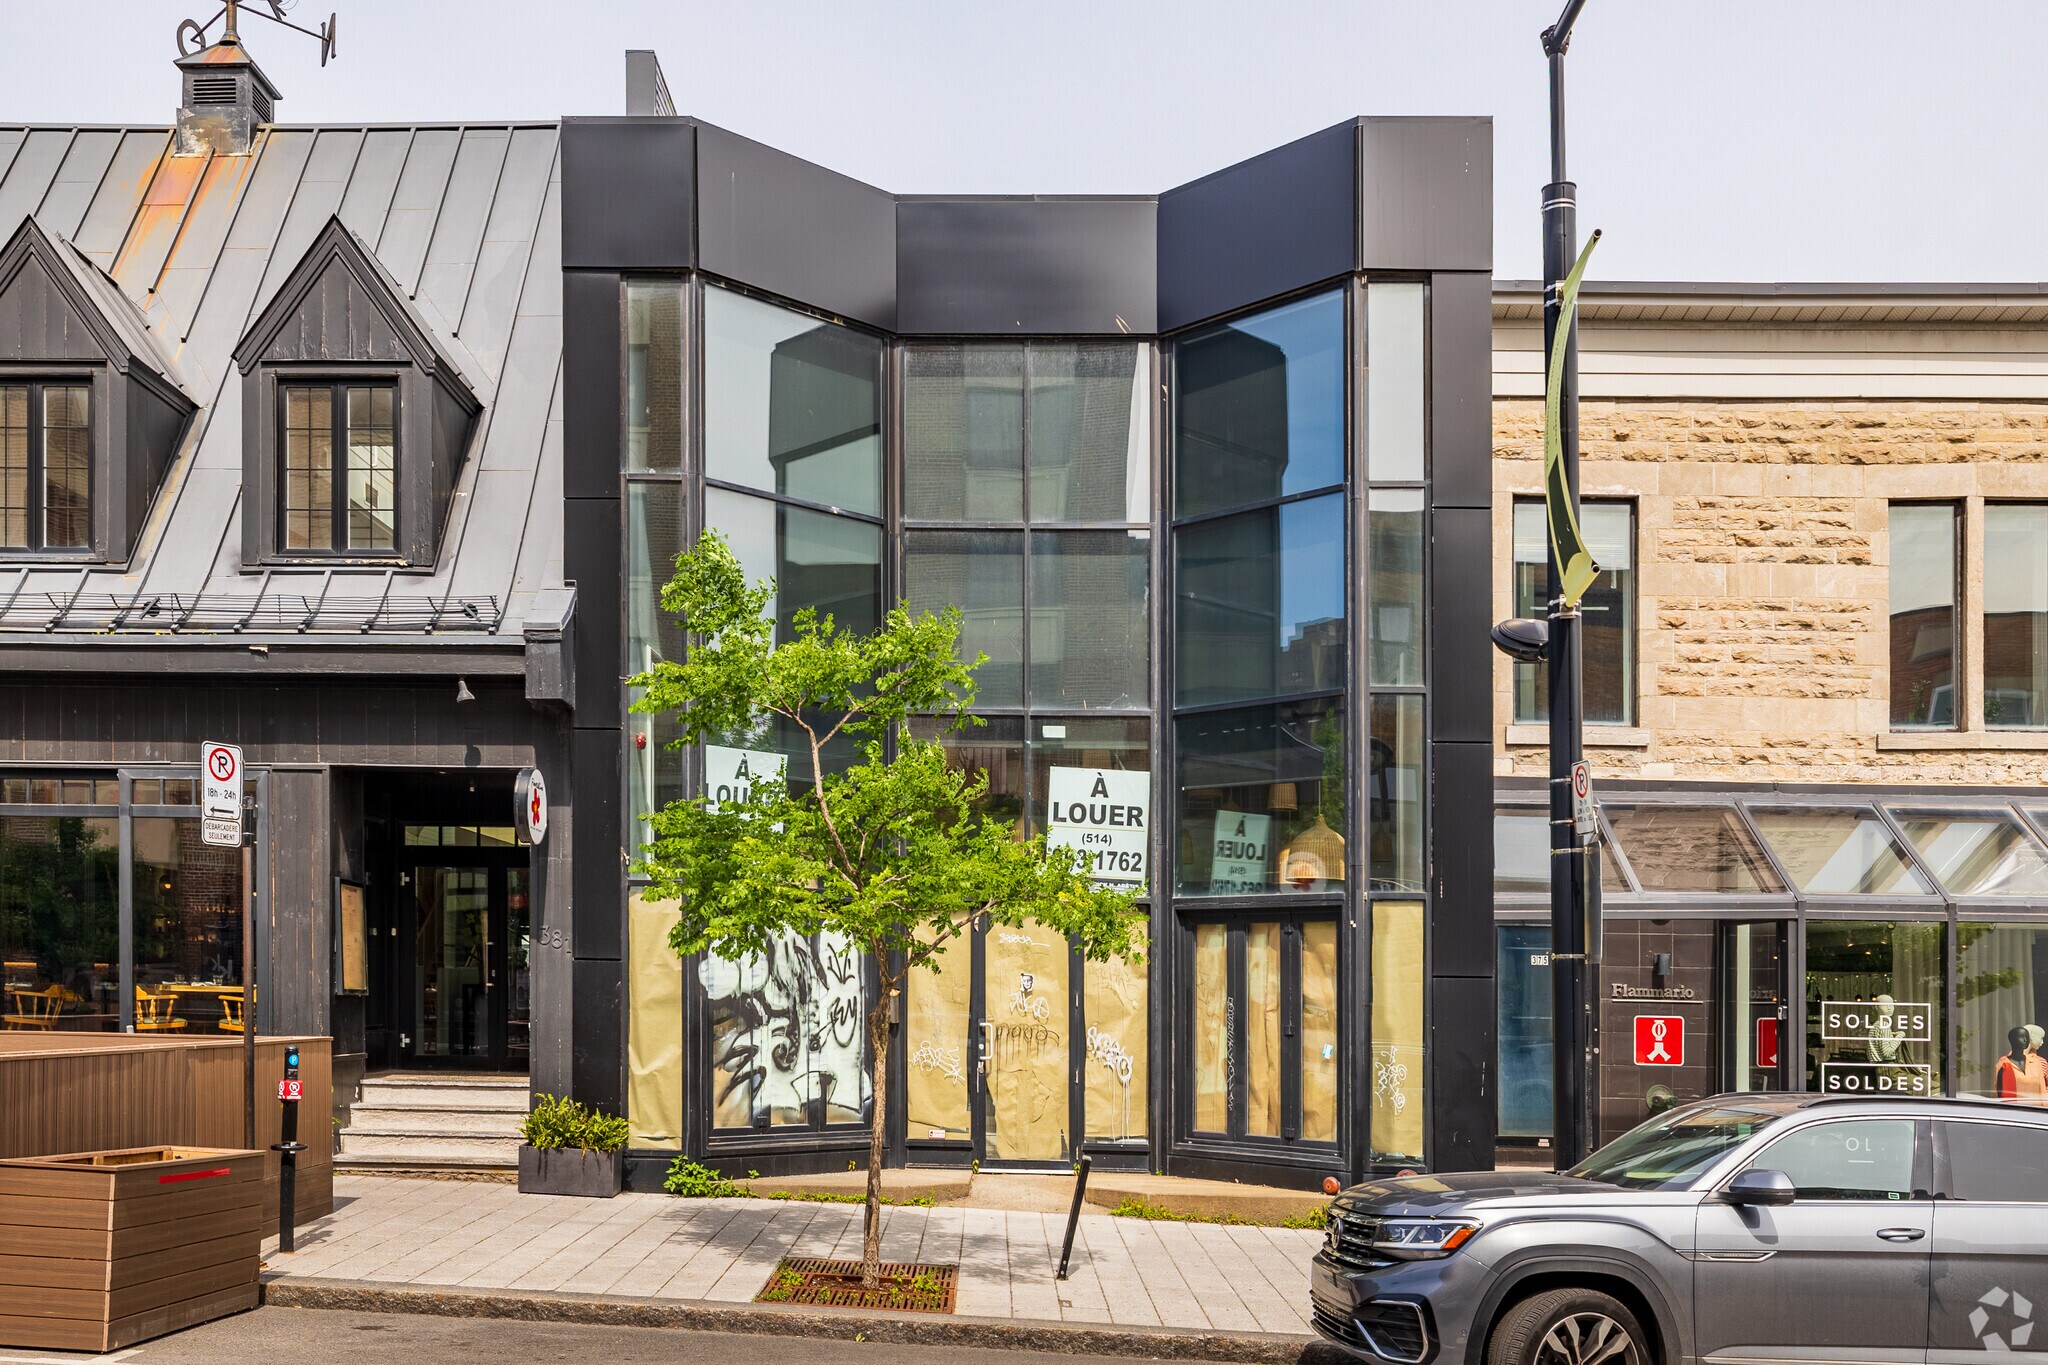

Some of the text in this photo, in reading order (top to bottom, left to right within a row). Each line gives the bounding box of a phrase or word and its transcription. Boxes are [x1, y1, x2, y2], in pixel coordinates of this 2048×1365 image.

[734, 752, 751, 781] À
[1090, 771, 1109, 798] À
[207, 787, 218, 798] 18h
[224, 789, 237, 800] 24h
[1052, 801, 1144, 827] LOUER
[208, 832, 236, 841] SEULEMENT
[1081, 832, 1112, 847] (514)
[1531, 955, 1549, 965] 375
[1611, 982, 1695, 999] Flammario
[1829, 1013, 1925, 1030] SOLDES
[1829, 1075, 1924, 1091] SOLDES
